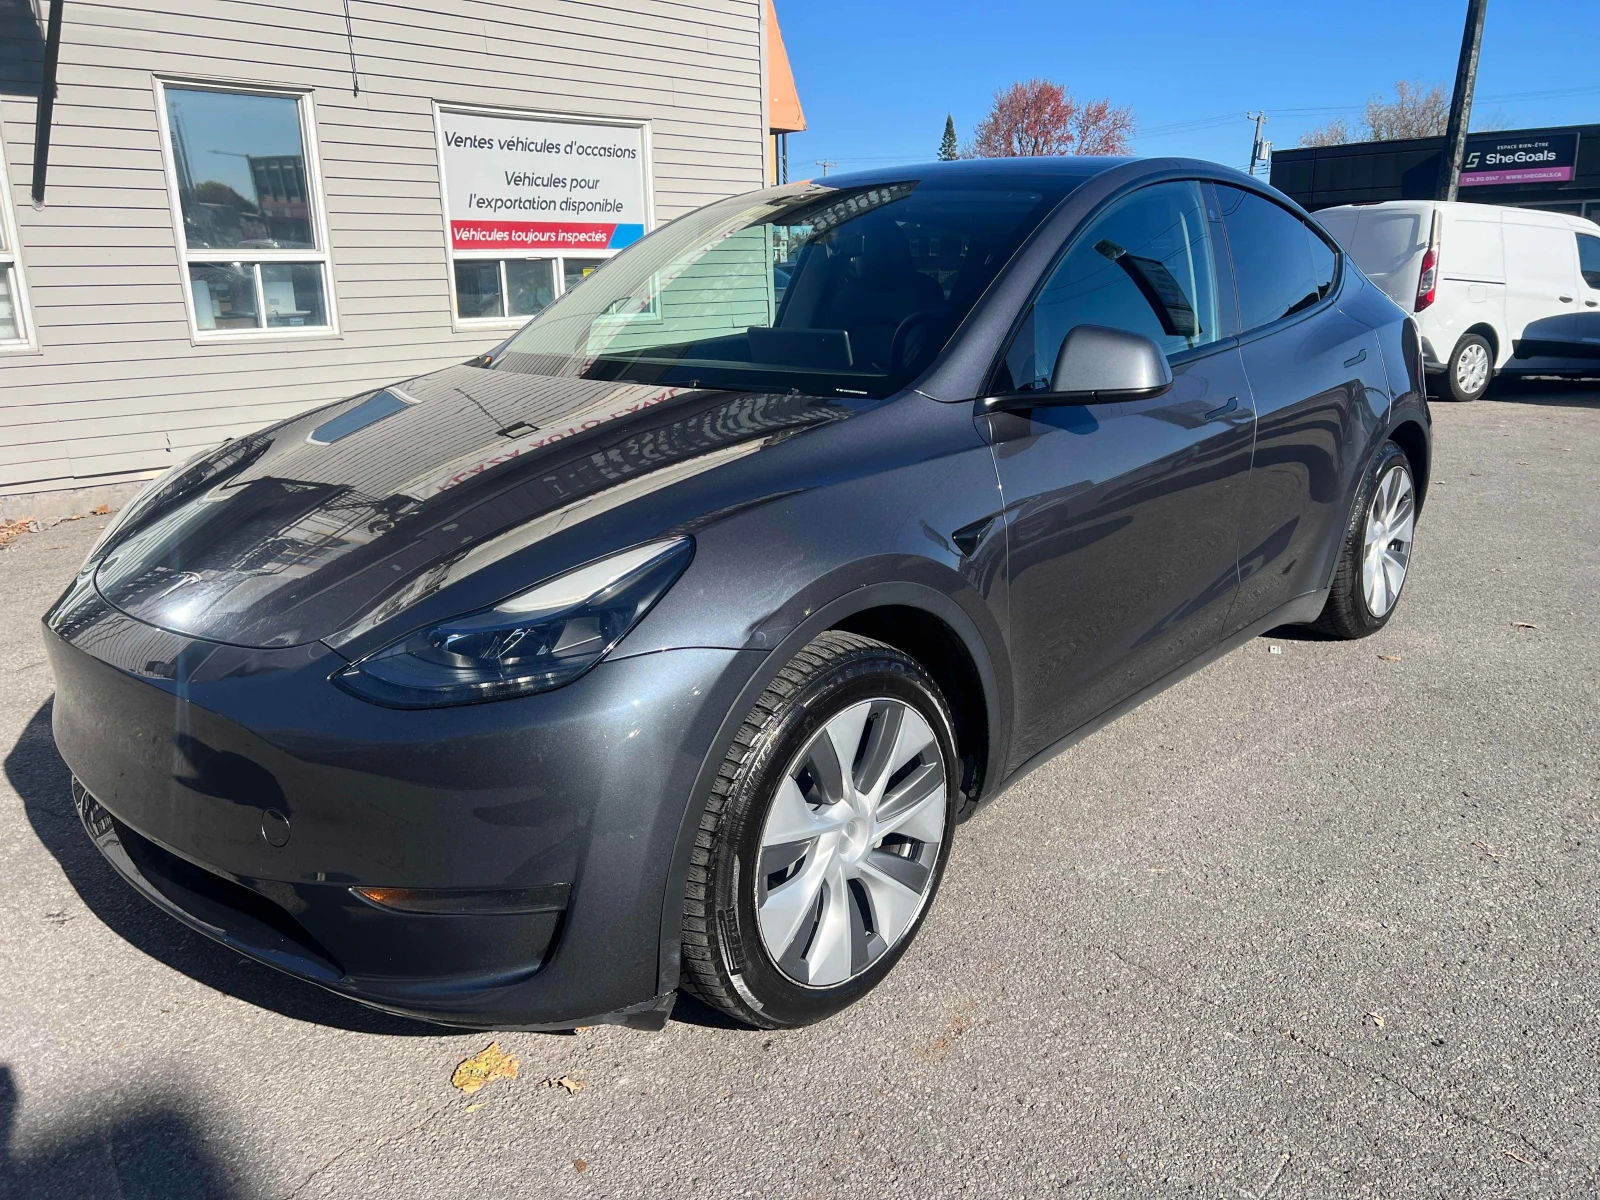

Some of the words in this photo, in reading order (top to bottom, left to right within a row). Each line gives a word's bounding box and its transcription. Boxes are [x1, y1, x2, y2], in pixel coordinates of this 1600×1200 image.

[444, 131, 494, 150] Ventes
[498, 136, 561, 155] véhicules
[564, 140, 637, 159] d'occasions
[1485, 151, 1556, 165] SheGoals
[504, 171, 567, 189] Véhicules
[569, 178, 600, 193] pour
[468, 193, 557, 213] l'exportation
[559, 198, 624, 216] disponible
[453, 228, 509, 242] Véhicules
[511, 229, 555, 244] toujours
[557, 230, 607, 245] inspectés
